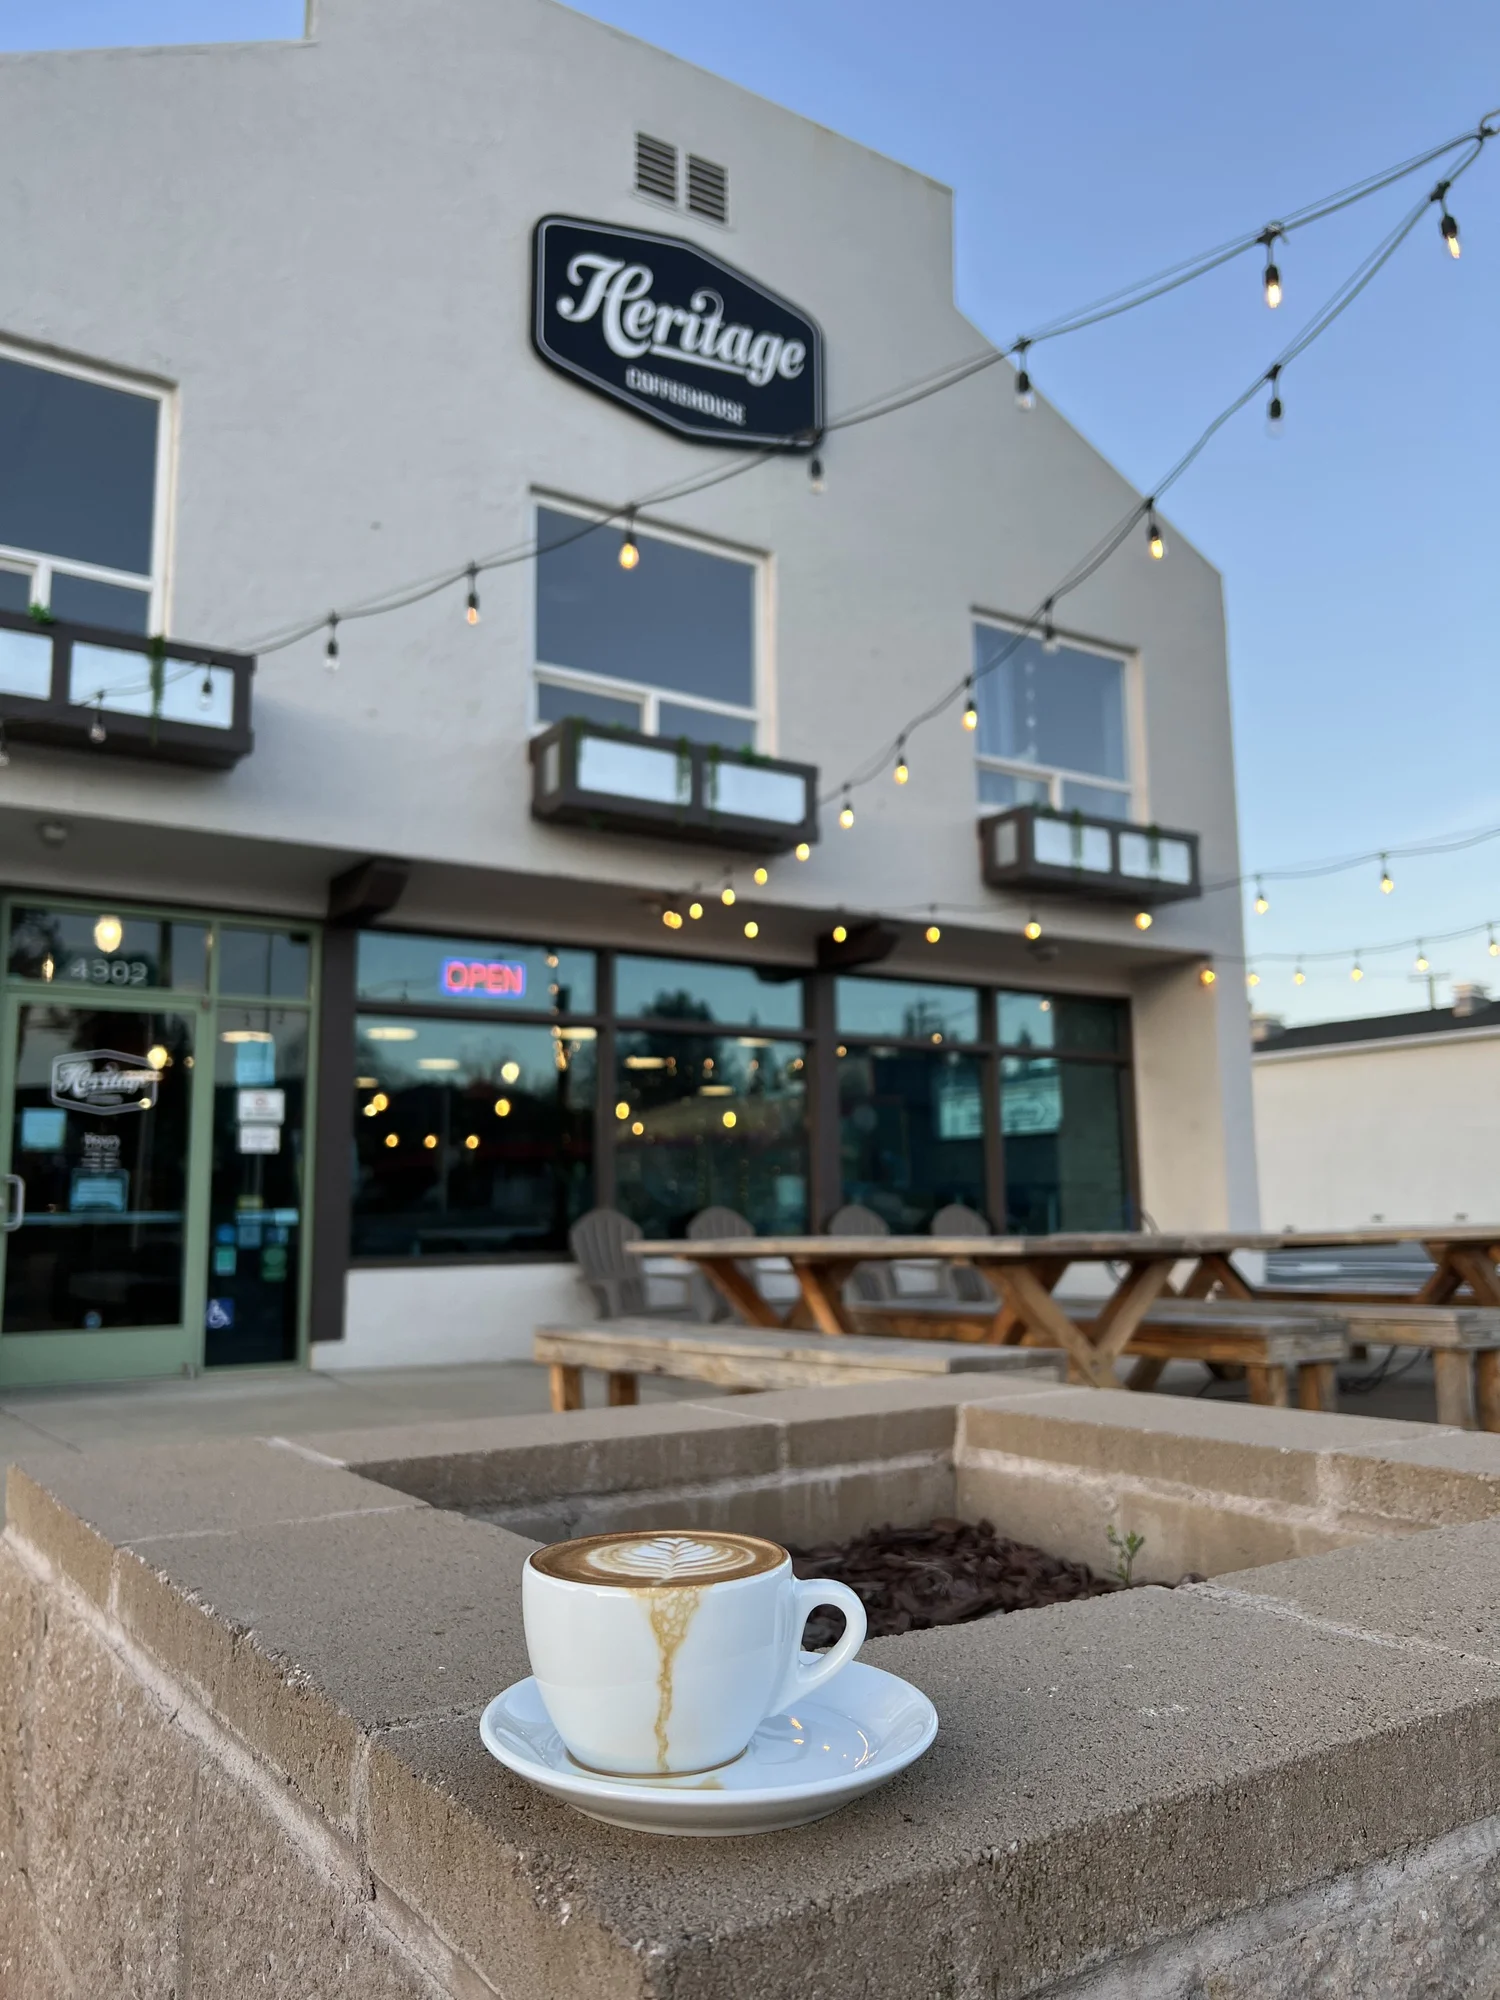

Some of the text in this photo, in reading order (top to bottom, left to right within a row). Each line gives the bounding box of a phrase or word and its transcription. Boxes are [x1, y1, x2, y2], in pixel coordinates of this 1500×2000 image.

[556, 253, 806, 387] Heritage
[626, 365, 747, 426] COFFEEHOUSE
[447, 961, 523, 995] OPEN
